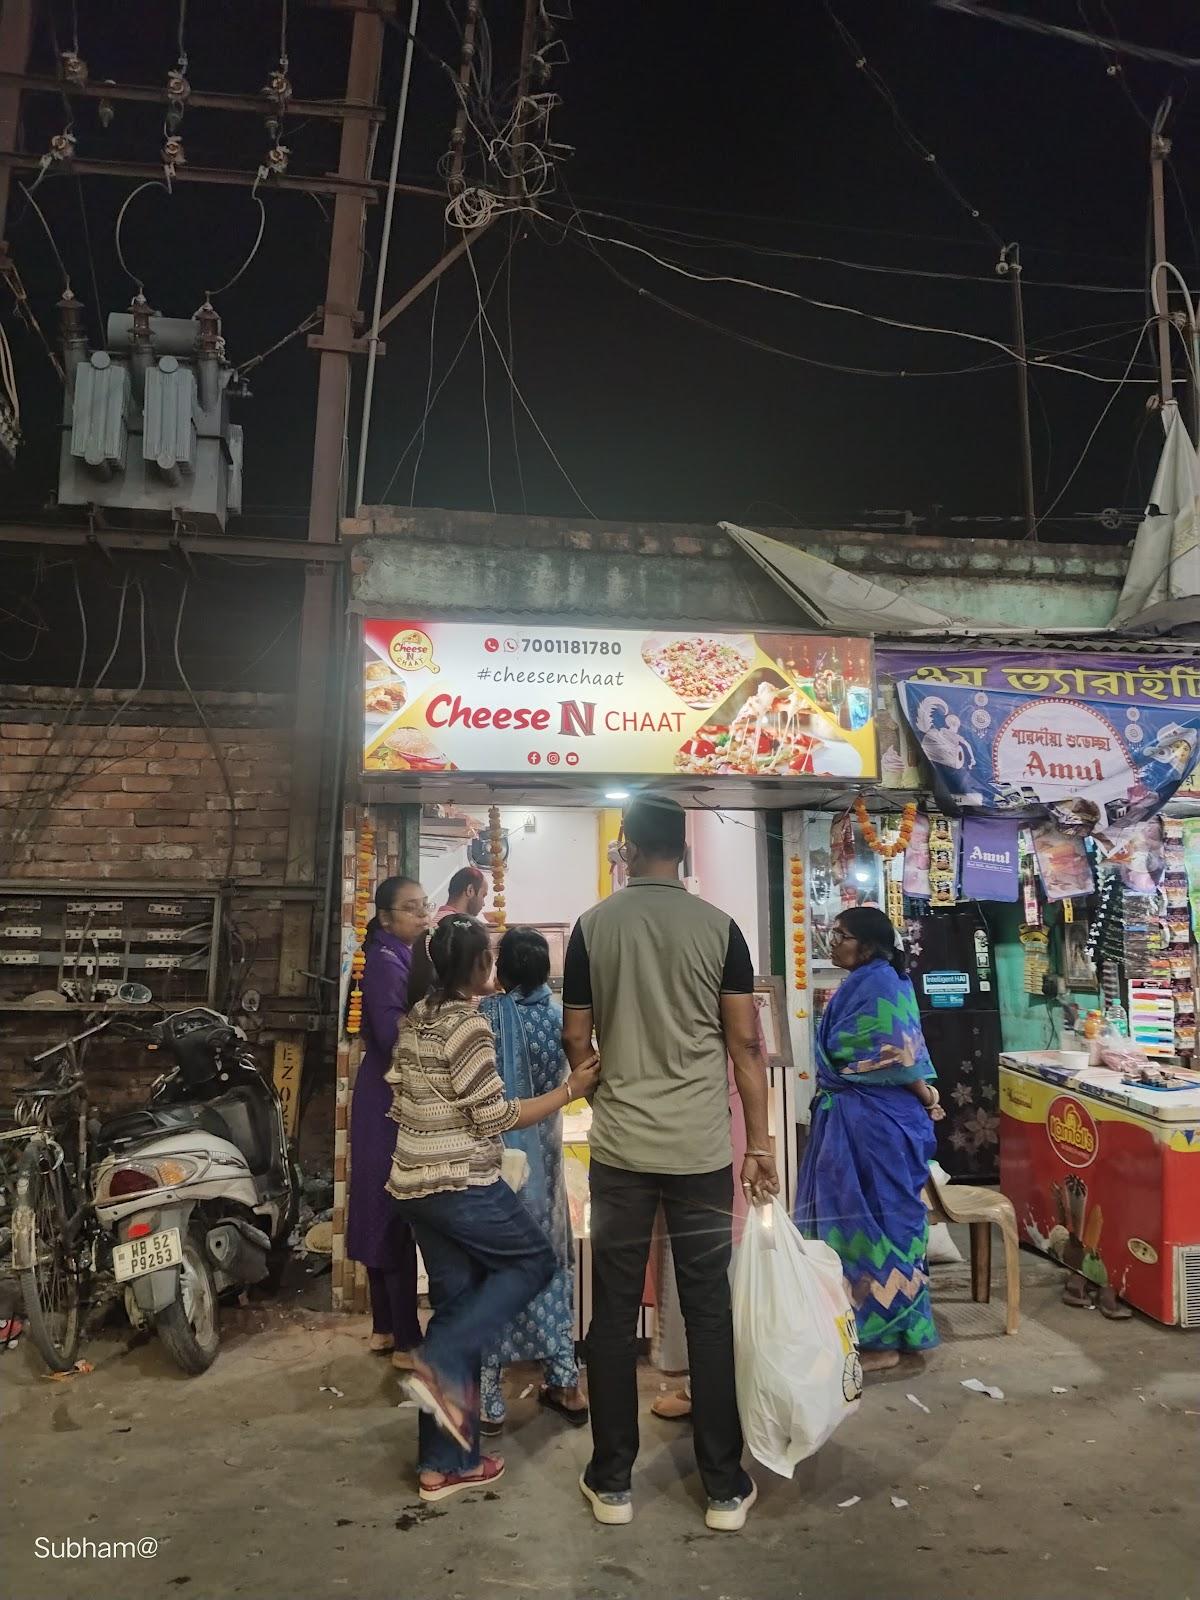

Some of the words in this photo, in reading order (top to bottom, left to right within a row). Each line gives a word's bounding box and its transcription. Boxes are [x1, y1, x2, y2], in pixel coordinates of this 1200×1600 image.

[393, 643, 428, 653] Cheese
[521, 639, 622, 655] 7001181780
[396, 657, 425, 667] CHAAT
[477, 666, 624, 687] #cheesenchaat
[425, 693, 551, 730] Cheese
[556, 699, 598, 737] N
[604, 710, 686, 732] CHAAT
[1023, 750, 1105, 781] Amul
[969, 845, 1010, 864] Amul
[131, 1240, 147, 1258] WB
[153, 1234, 170, 1250] 52
[131, 1248, 173, 1273] P9253
